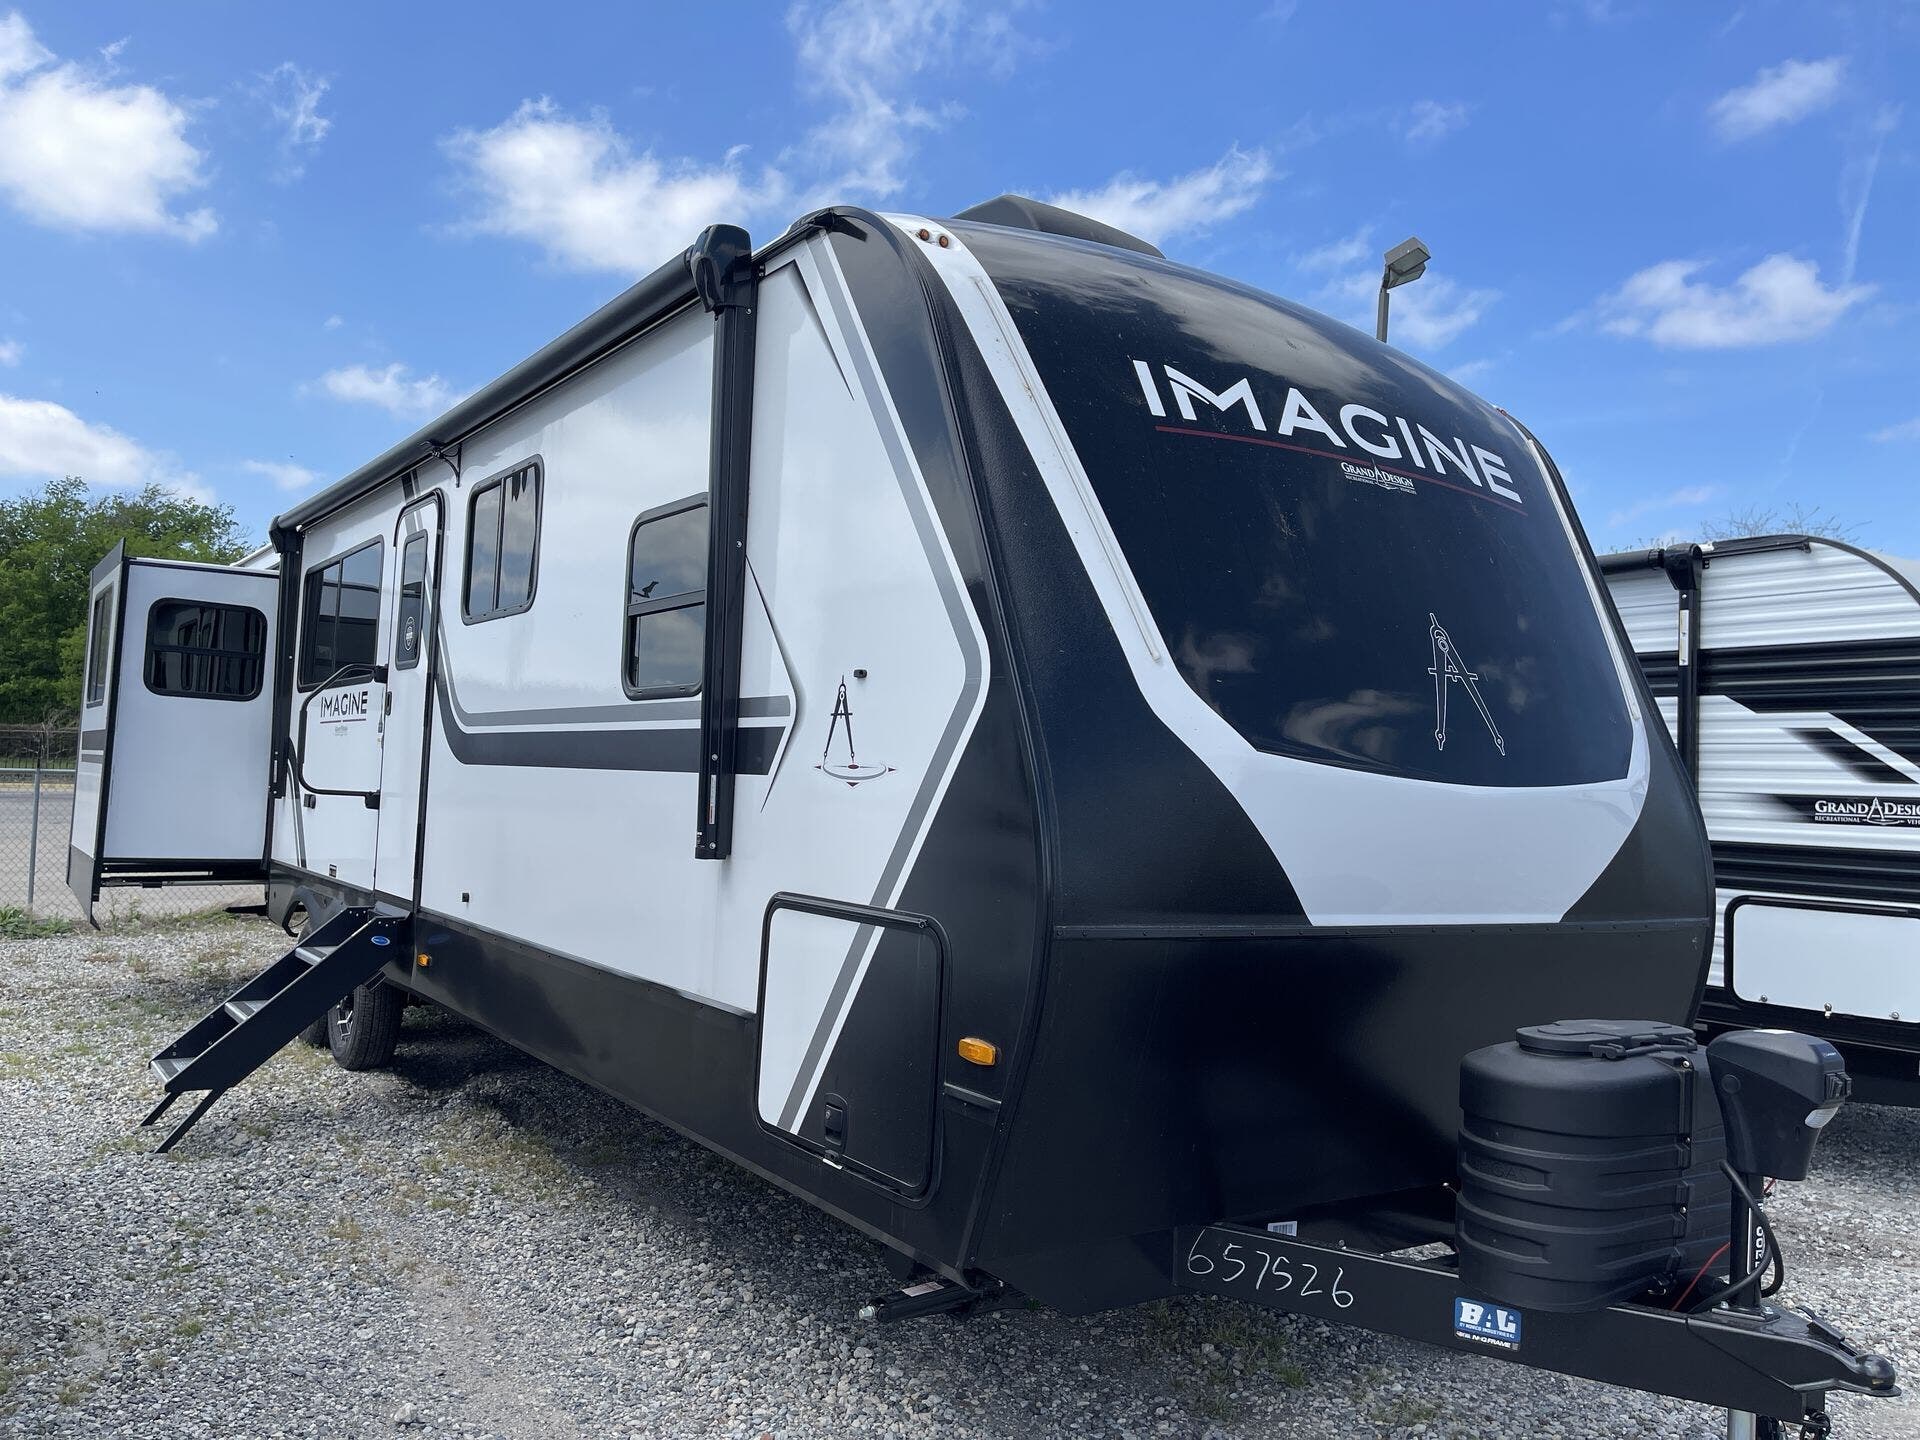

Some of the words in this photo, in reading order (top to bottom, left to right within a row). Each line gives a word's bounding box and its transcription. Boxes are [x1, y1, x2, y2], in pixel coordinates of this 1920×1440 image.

[1133, 360, 1522, 503] IMAGINE
[1341, 462, 1375, 478] GRAND
[1381, 471, 1414, 487] DESIGN
[320, 691, 368, 717] IMAGINE
[1815, 800, 1869, 814] GRAND
[1188, 1227, 1354, 1309] 657526
[1460, 1301, 1516, 1333] BAL
